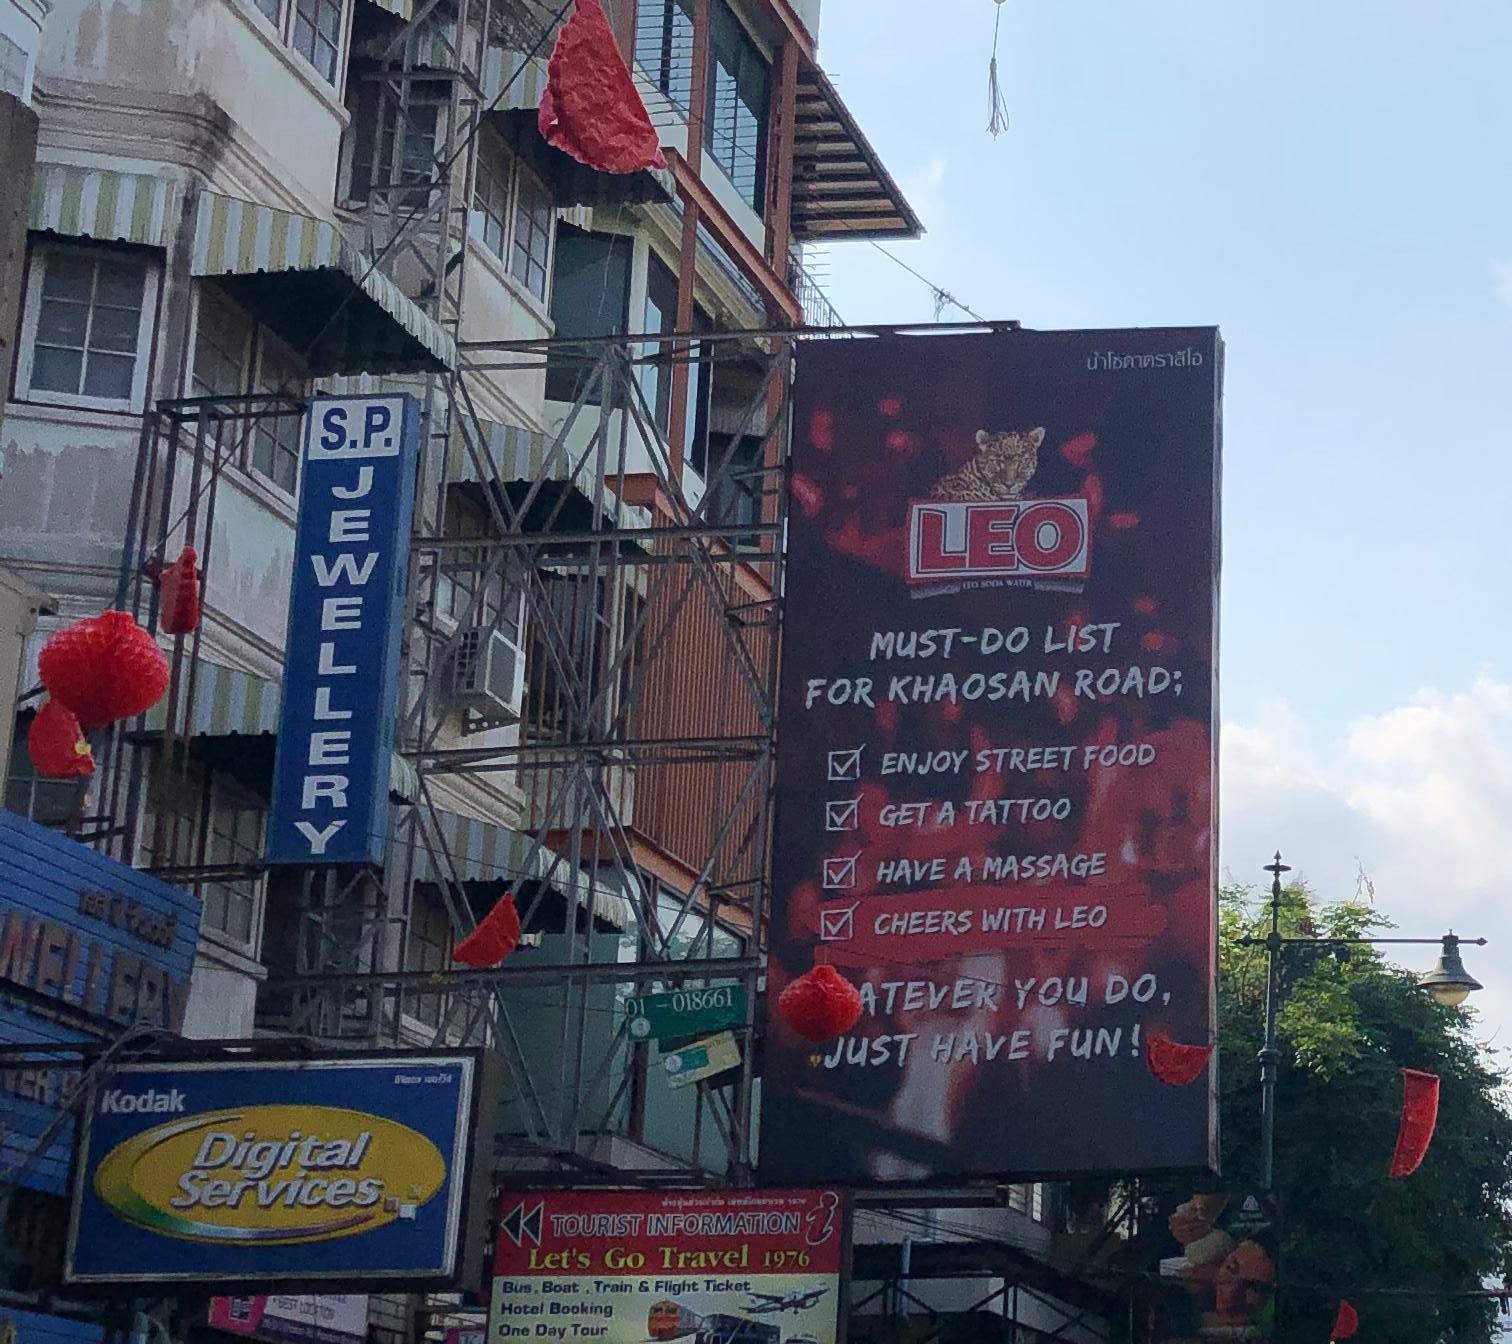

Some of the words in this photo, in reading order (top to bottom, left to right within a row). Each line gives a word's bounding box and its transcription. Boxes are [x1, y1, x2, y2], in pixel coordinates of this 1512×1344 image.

[319, 405, 394, 452] S.P.
[916, 501, 1084, 574] LEO
[870, 626, 1030, 660] MUST-DO
[1044, 622, 1121, 655] LIST
[293, 465, 380, 855] JEWELLERY
[805, 677, 875, 710] FOR
[888, 669, 1060, 705] KHAOSAN
[881, 748, 968, 775] ENJOY
[975, 745, 1073, 773] STREET
[1082, 743, 1156, 770] FOOD
[879, 801, 931, 828] GET
[935, 803, 955, 826] A
[965, 798, 1072, 826] TATTOO
[876, 857, 947, 884] HAVE
[953, 857, 973, 880] A
[982, 852, 1108, 880] MASSAGE
[873, 907, 974, 936] CHEERS
[981, 906, 1046, 933] WITH
[1054, 904, 1109, 930] LEO
[672, 987, 734, 1013] 018661
[860, 978, 1000, 1014] ATEVER
[1013, 976, 1089, 1010] YOU
[1104, 973, 1172, 1007] DO,
[823, 1033, 918, 1069] JUST
[930, 1029, 1033, 1064] HAVE
[1046, 1024, 1142, 1061] FUN!
[101, 1089, 186, 1113] Kodak
[193, 1129, 371, 1181] Digital
[171, 1170, 384, 1211] Services
[551, 1214, 643, 1238] TOURIST
[647, 1211, 801, 1237] INFORMATION
[528, 1246, 592, 1271] Let's
[604, 1247, 645, 1270] Go
[659, 1244, 749, 1269] Travel
[762, 1248, 811, 1269] 1976
[593, 1279, 634, 1294] Train
[653, 1279, 700, 1297] Flight
[703, 1278, 751, 1293] Ticket
[500, 1302, 545, 1316] Hotel
[549, 1302, 614, 1318] Booking
[498, 1324, 530, 1337] One
[535, 1323, 567, 1340] Day
[571, 1323, 609, 1337] Tour
